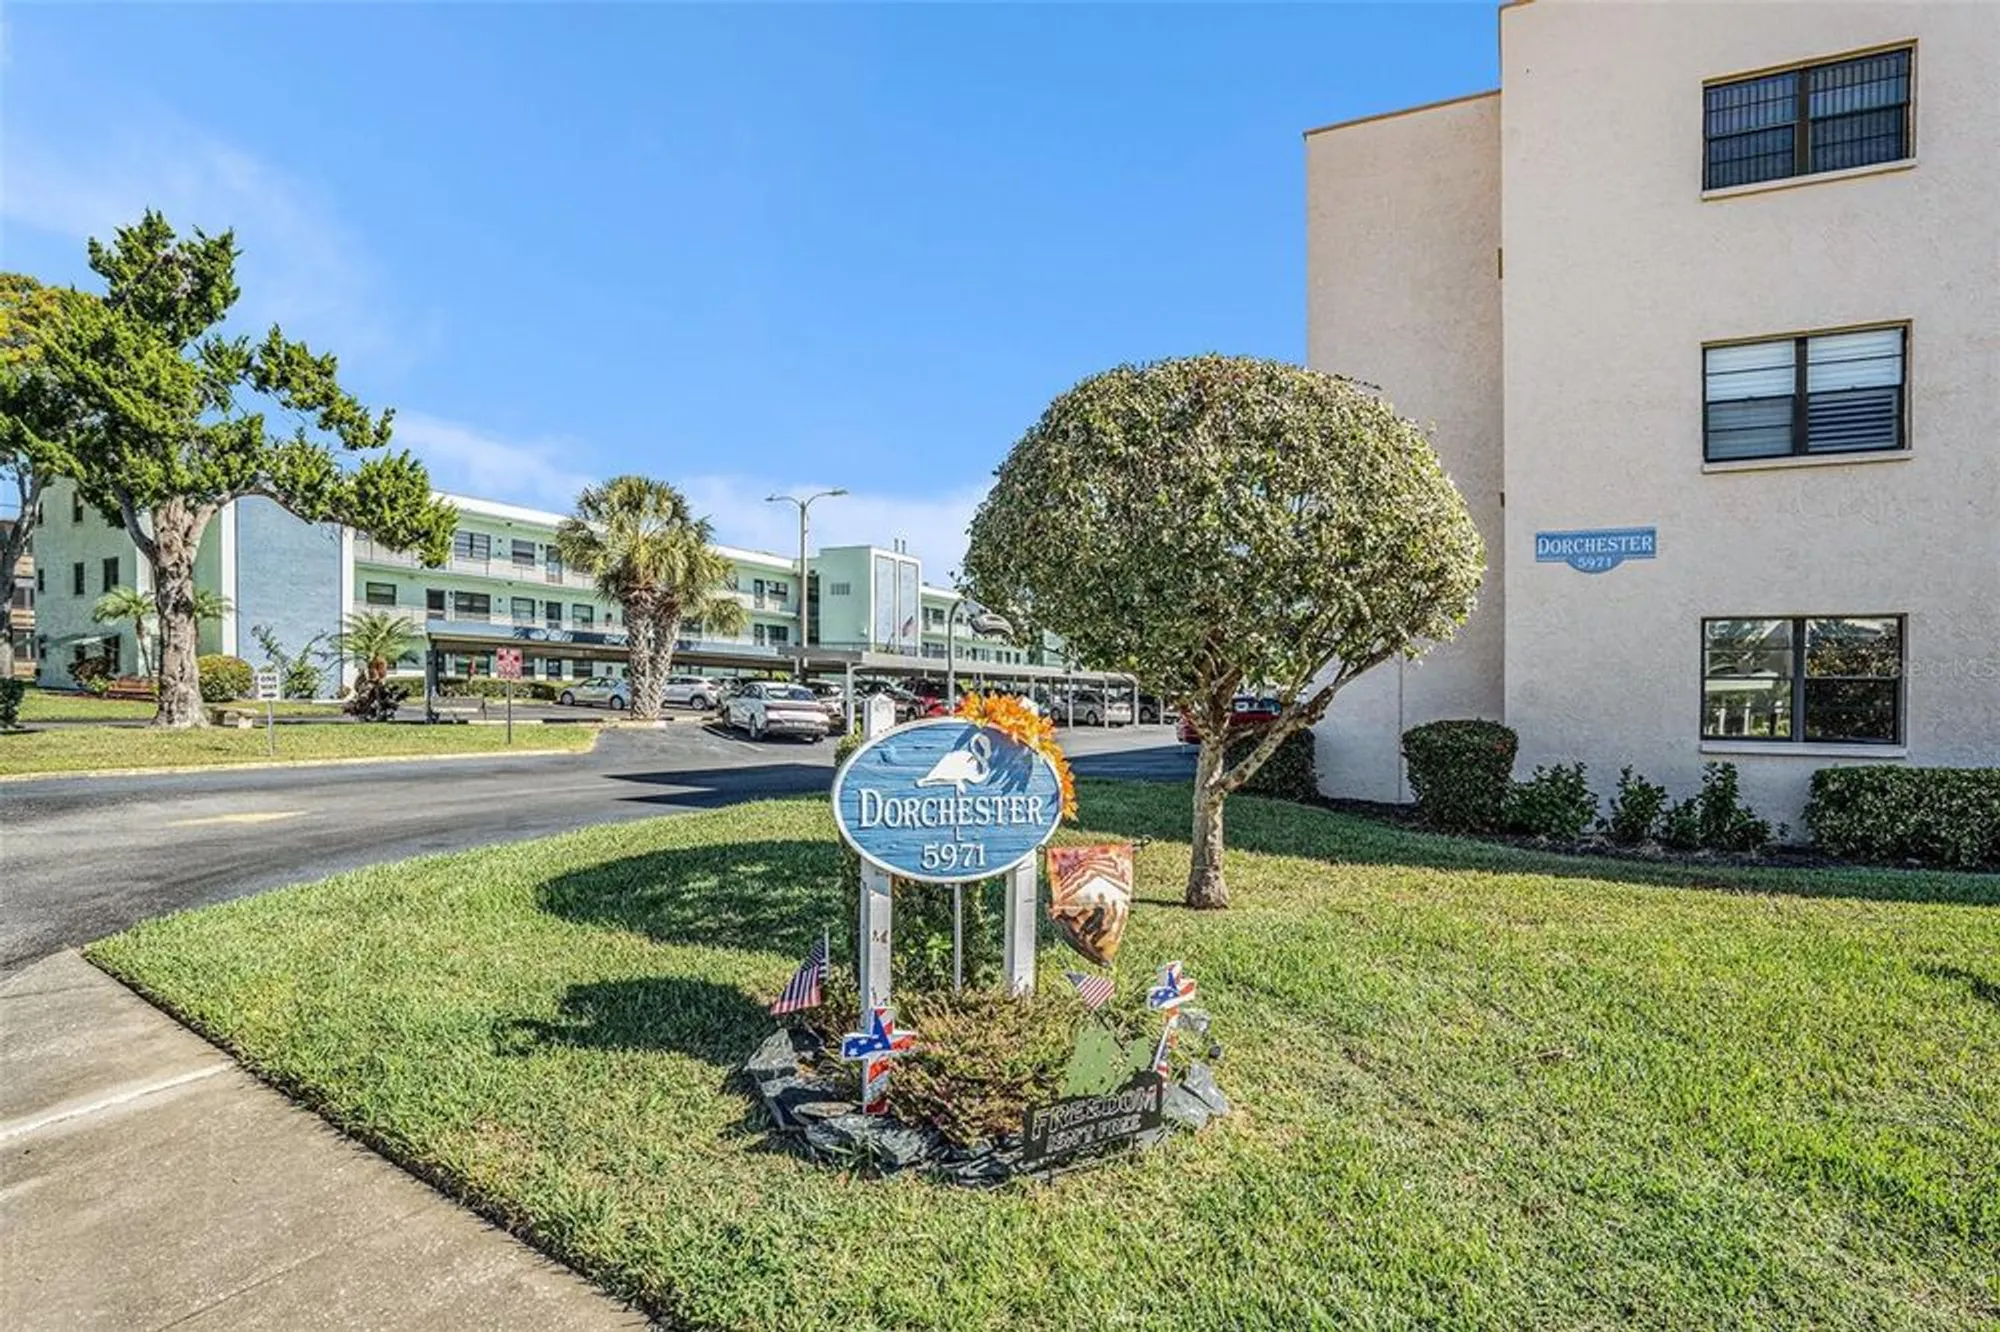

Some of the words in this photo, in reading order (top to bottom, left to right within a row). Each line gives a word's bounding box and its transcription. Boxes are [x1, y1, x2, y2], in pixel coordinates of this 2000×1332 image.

[1537, 535, 1653, 555] DORCHESTER
[1577, 556, 1612, 569] 5971
[858, 787, 1044, 829] DORCHESTER
[921, 842, 985, 870] 5971
[1031, 1084, 1157, 1142] FREEDOM
[1097, 1113, 1142, 1139] FREE
